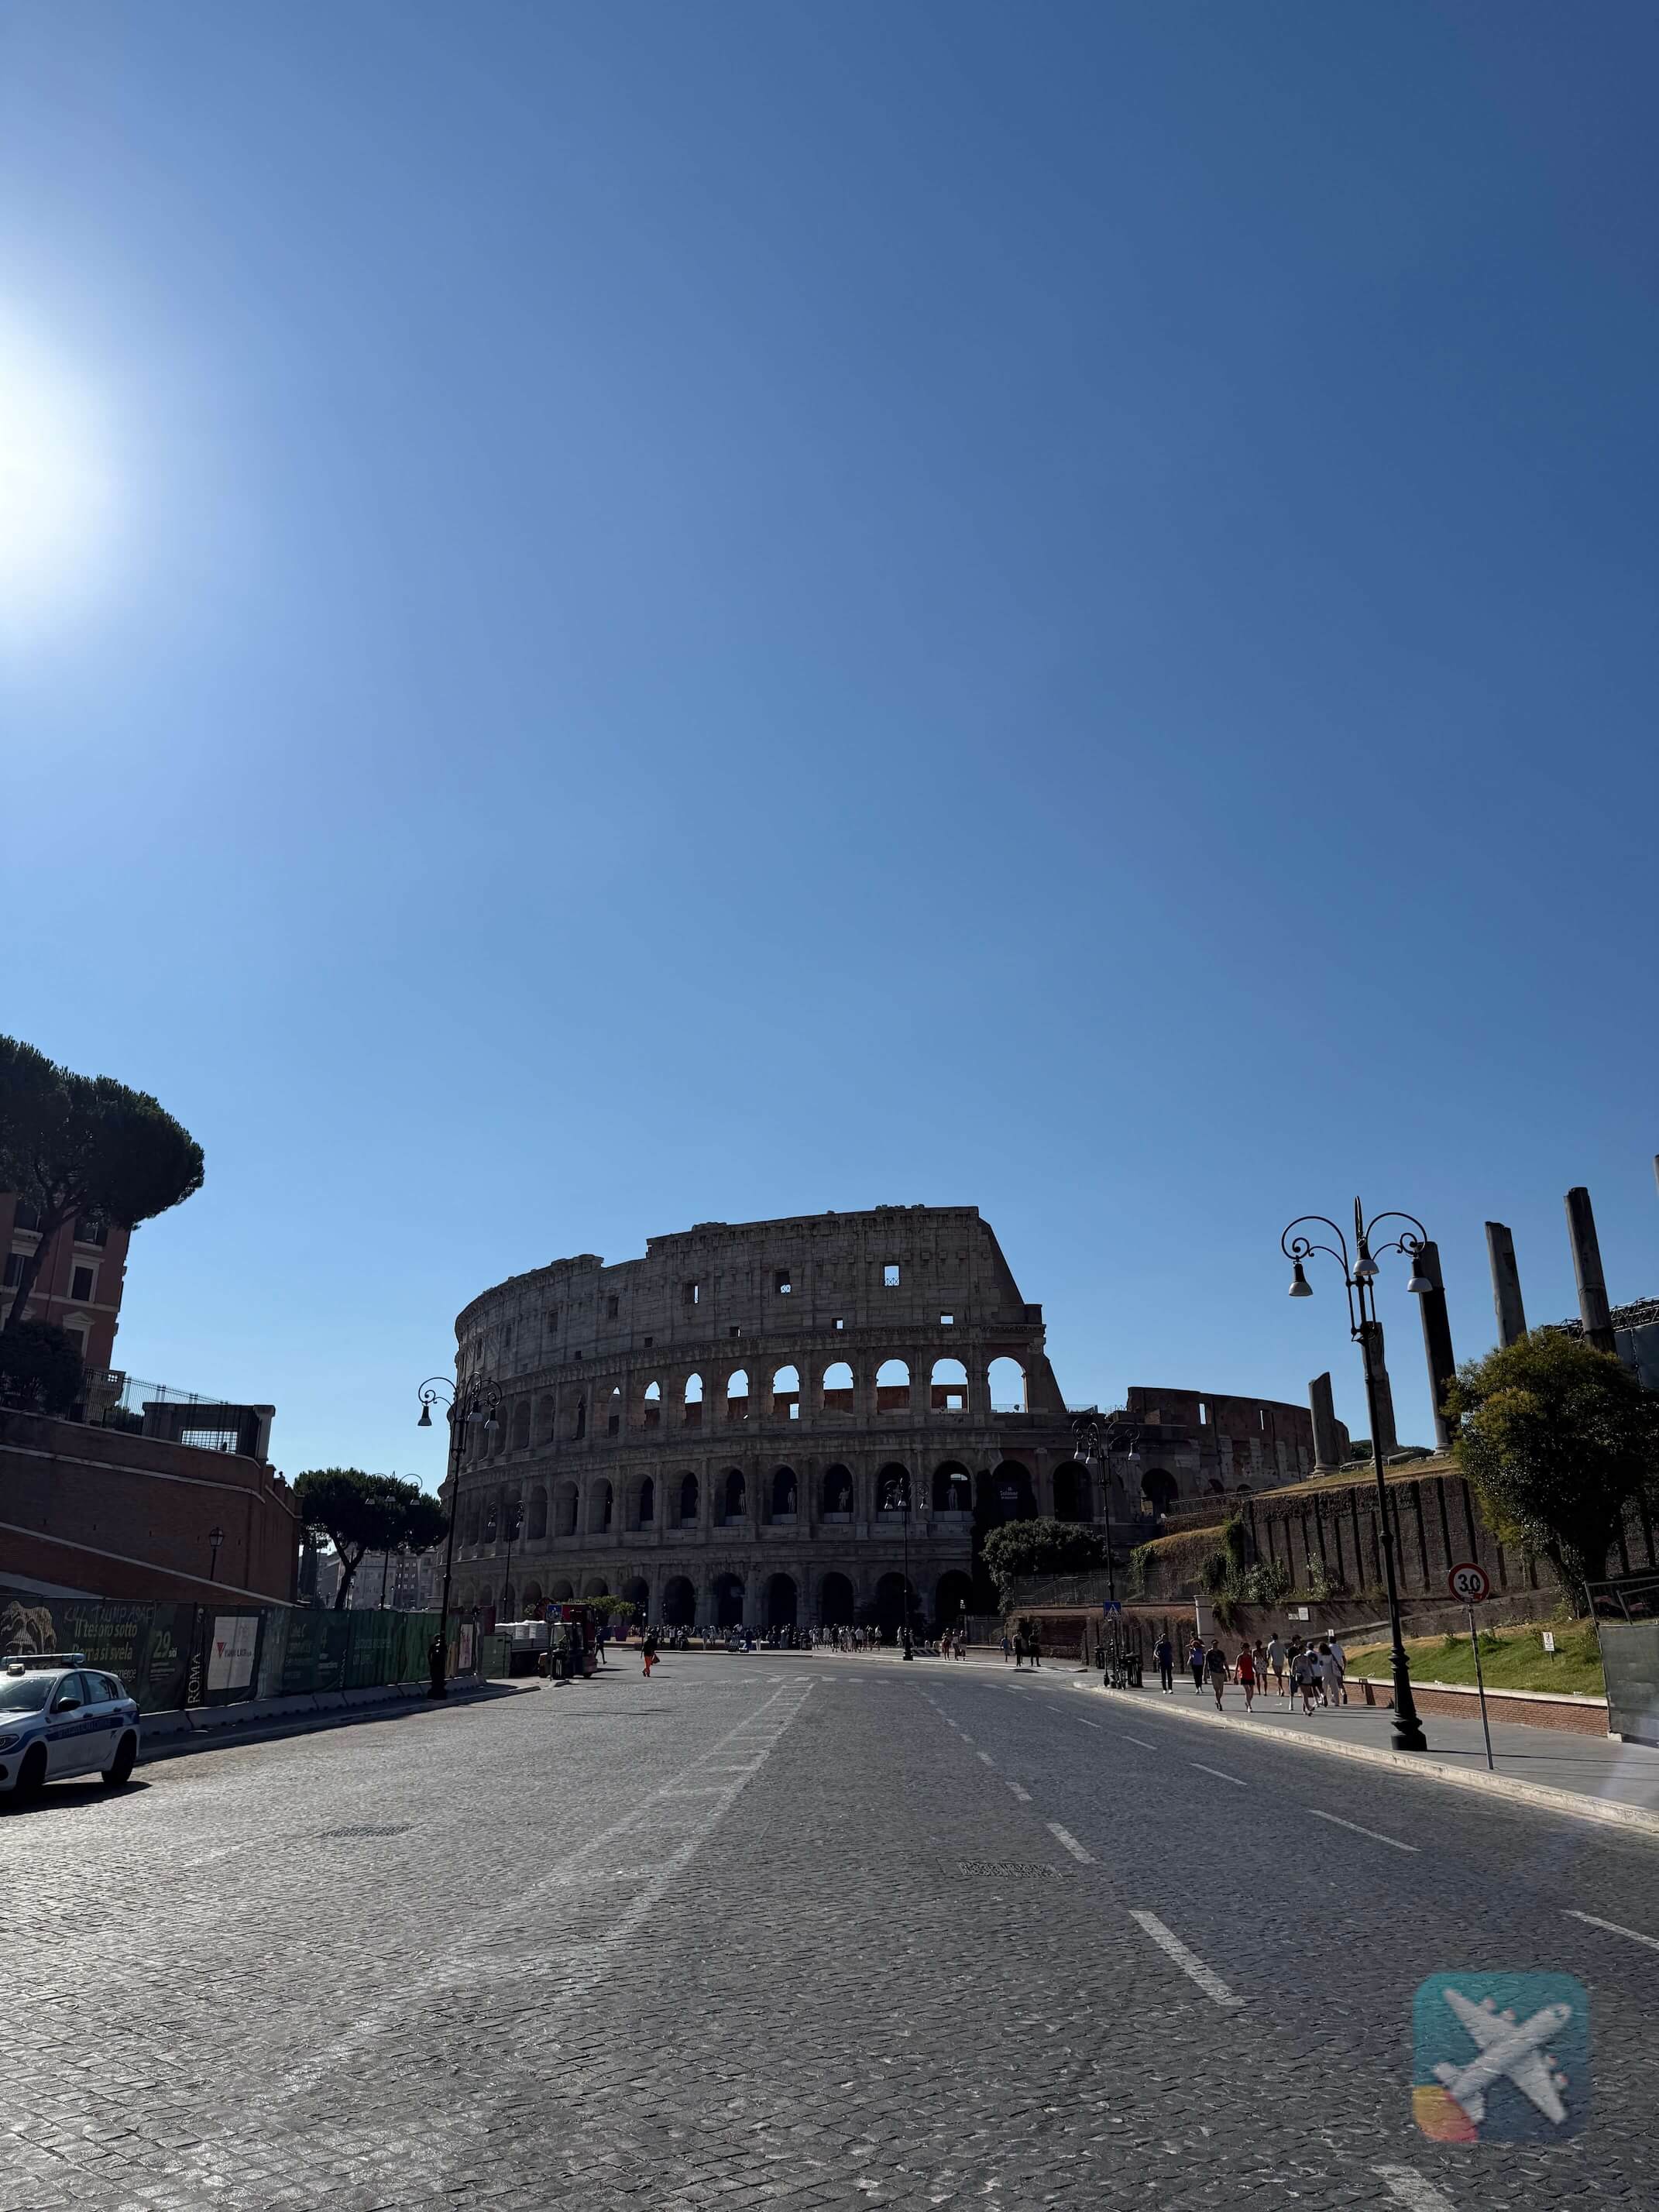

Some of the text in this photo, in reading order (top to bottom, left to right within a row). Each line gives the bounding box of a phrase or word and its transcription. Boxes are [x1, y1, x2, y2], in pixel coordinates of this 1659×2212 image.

[1458, 1574, 1481, 1592] 30
[83, 1622, 114, 1638] tesoro
[114, 1622, 138, 1638] sotto
[100, 1643, 109, 1661] si
[110, 1641, 133, 1661] svela
[153, 1630, 171, 1659] 29
[187, 1651, 201, 1704] ROMA
